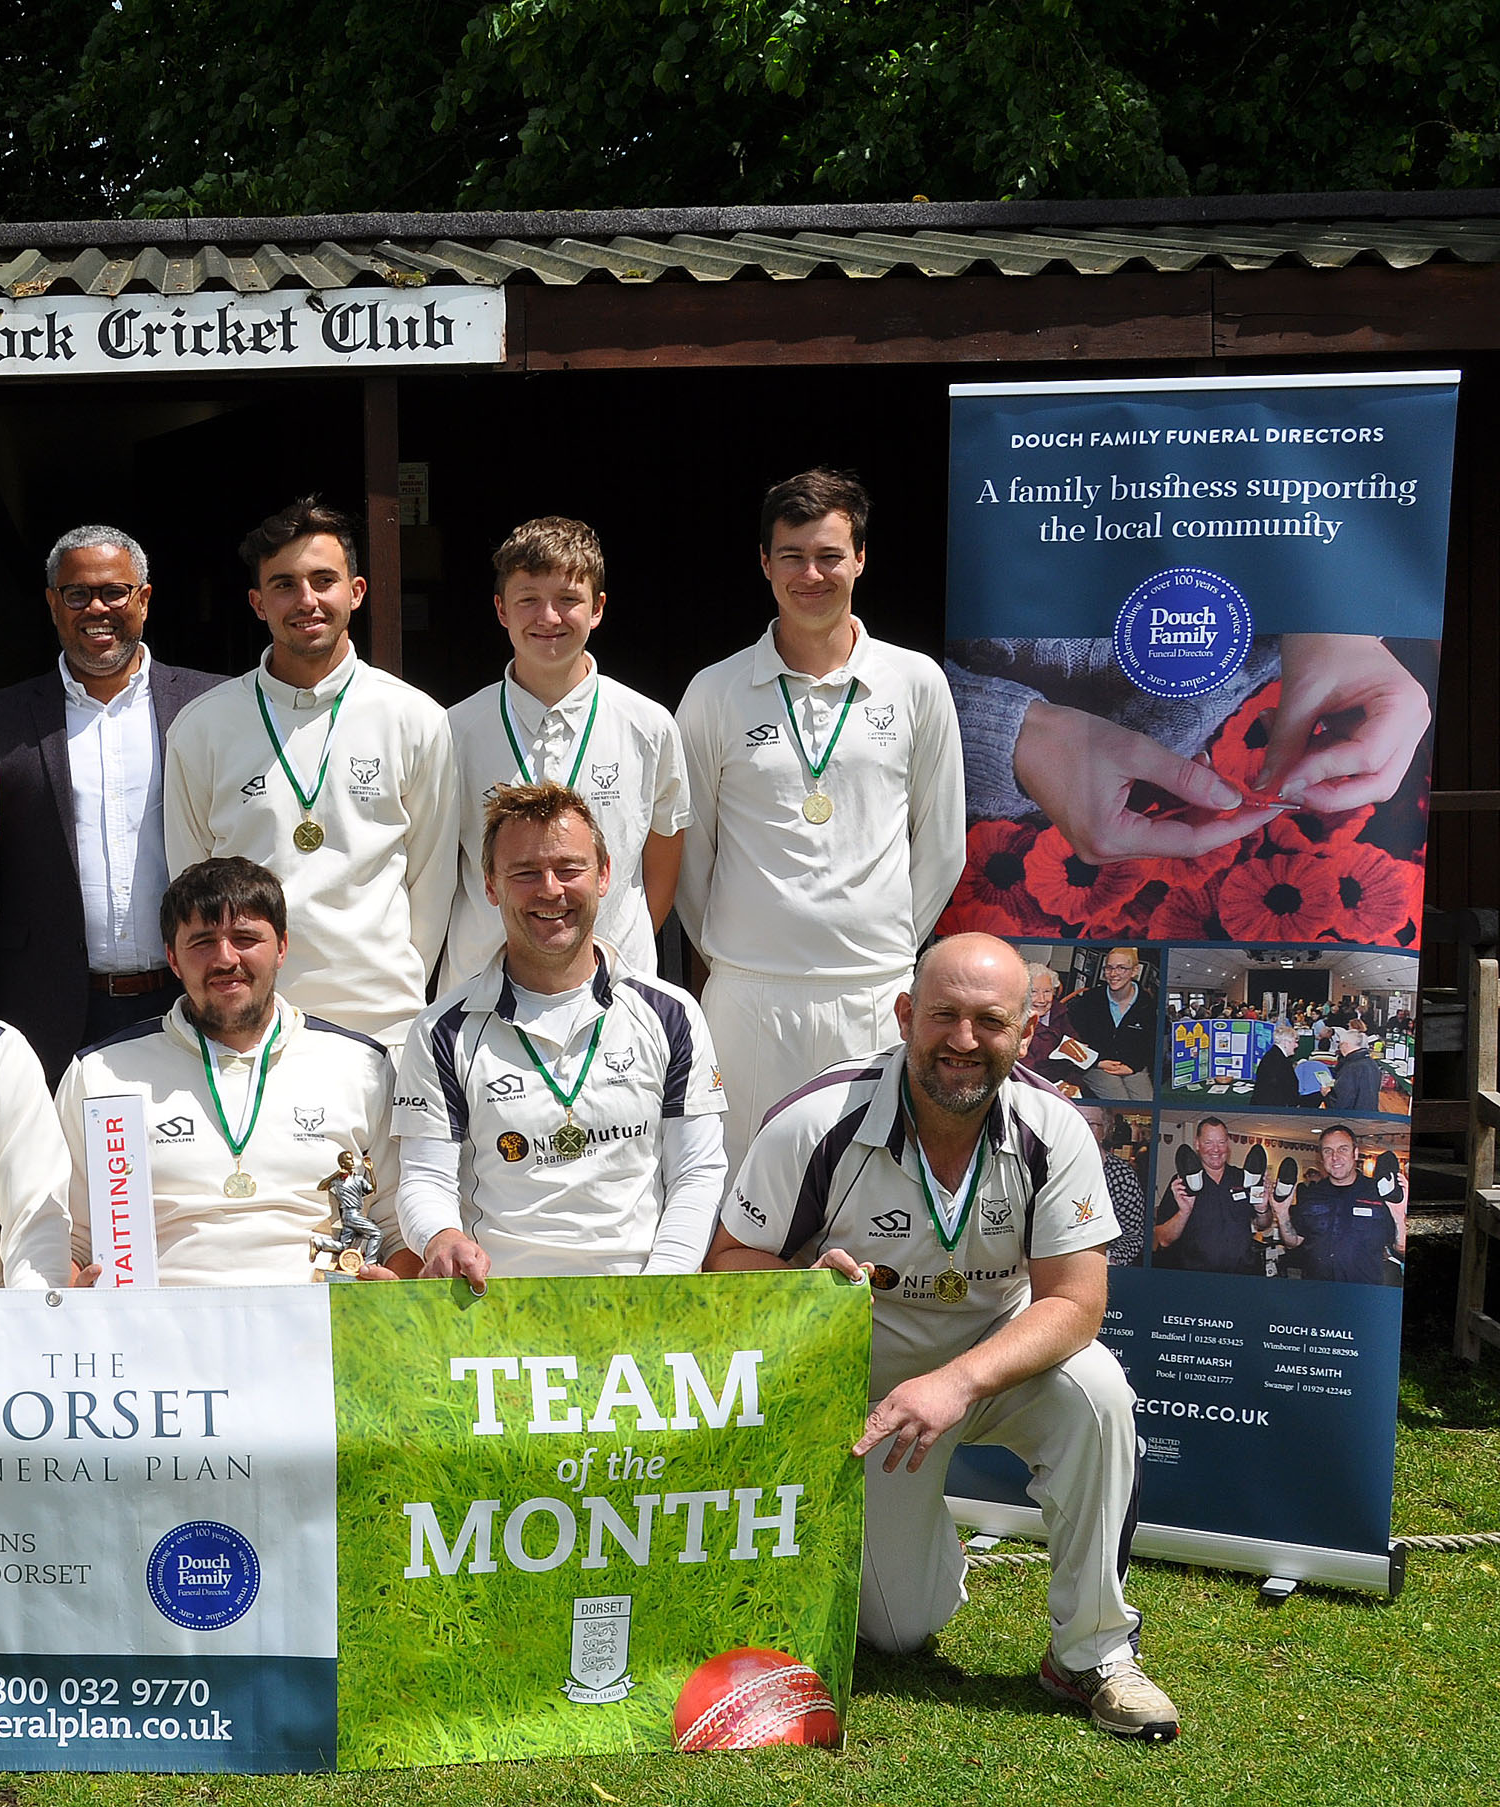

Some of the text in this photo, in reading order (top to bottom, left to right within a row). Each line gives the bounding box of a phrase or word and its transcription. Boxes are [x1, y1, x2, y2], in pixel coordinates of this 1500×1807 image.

[97, 306, 299, 360] Cricket
[321, 300, 455, 354] Club
[1011, 427, 1385, 449] DOUCH FAMILY FUNERAL DIRECTORS
[976, 472, 1418, 509] A family business supporting
[1039, 511, 1343, 544] the local community
[1150, 575, 1219, 595] over 100 years
[1150, 606, 1217, 626] Douch
[1227, 602, 1243, 634] service
[1123, 601, 1144, 669] understanding
[1149, 626, 1218, 650] Family
[1148, 649, 1214, 658] Funeral Directors
[1219, 647, 1237, 668] trust
[1147, 674, 1167, 686] care
[1180, 675, 1208, 689] value
[746, 740, 781, 748] MASURI
[486, 1093, 527, 1103] MASURI
[106, 1116, 134, 1287] TAITTINGER
[868, 1231, 911, 1239] MASURI
[1163, 1315, 1234, 1329] LESLEY SHAND
[1151, 1331, 1244, 1347] Blandford 01258 453425
[1269, 1324, 1354, 1340] DOUCH & SMALL
[1263, 1341, 1359, 1357] Wimborne 01202 882936
[42, 1351, 126, 1380] THE
[1158, 1353, 1232, 1368] ALBERT MARSH
[1156, 1370, 1234, 1384] Poole 01202 621777
[1274, 1364, 1342, 1378] JAMES SMITH
[449, 1349, 765, 1436] TEAM
[1264, 1381, 1352, 1396] Swanage 01929 422445
[145, 1453, 254, 1481] PLAN
[556, 1446, 666, 1492] of the
[176, 1529, 230, 1544] over 100 years
[403, 1483, 805, 1579] MONTH
[178, 1554, 231, 1570] Douch
[178, 1570, 233, 1589] Family
[581, 1602, 623, 1615] DORSET
[59, 1678, 119, 1706] 032
[130, 1678, 209, 1707] 9770
[572, 1689, 623, 1699] CRICKET LEAGUE
